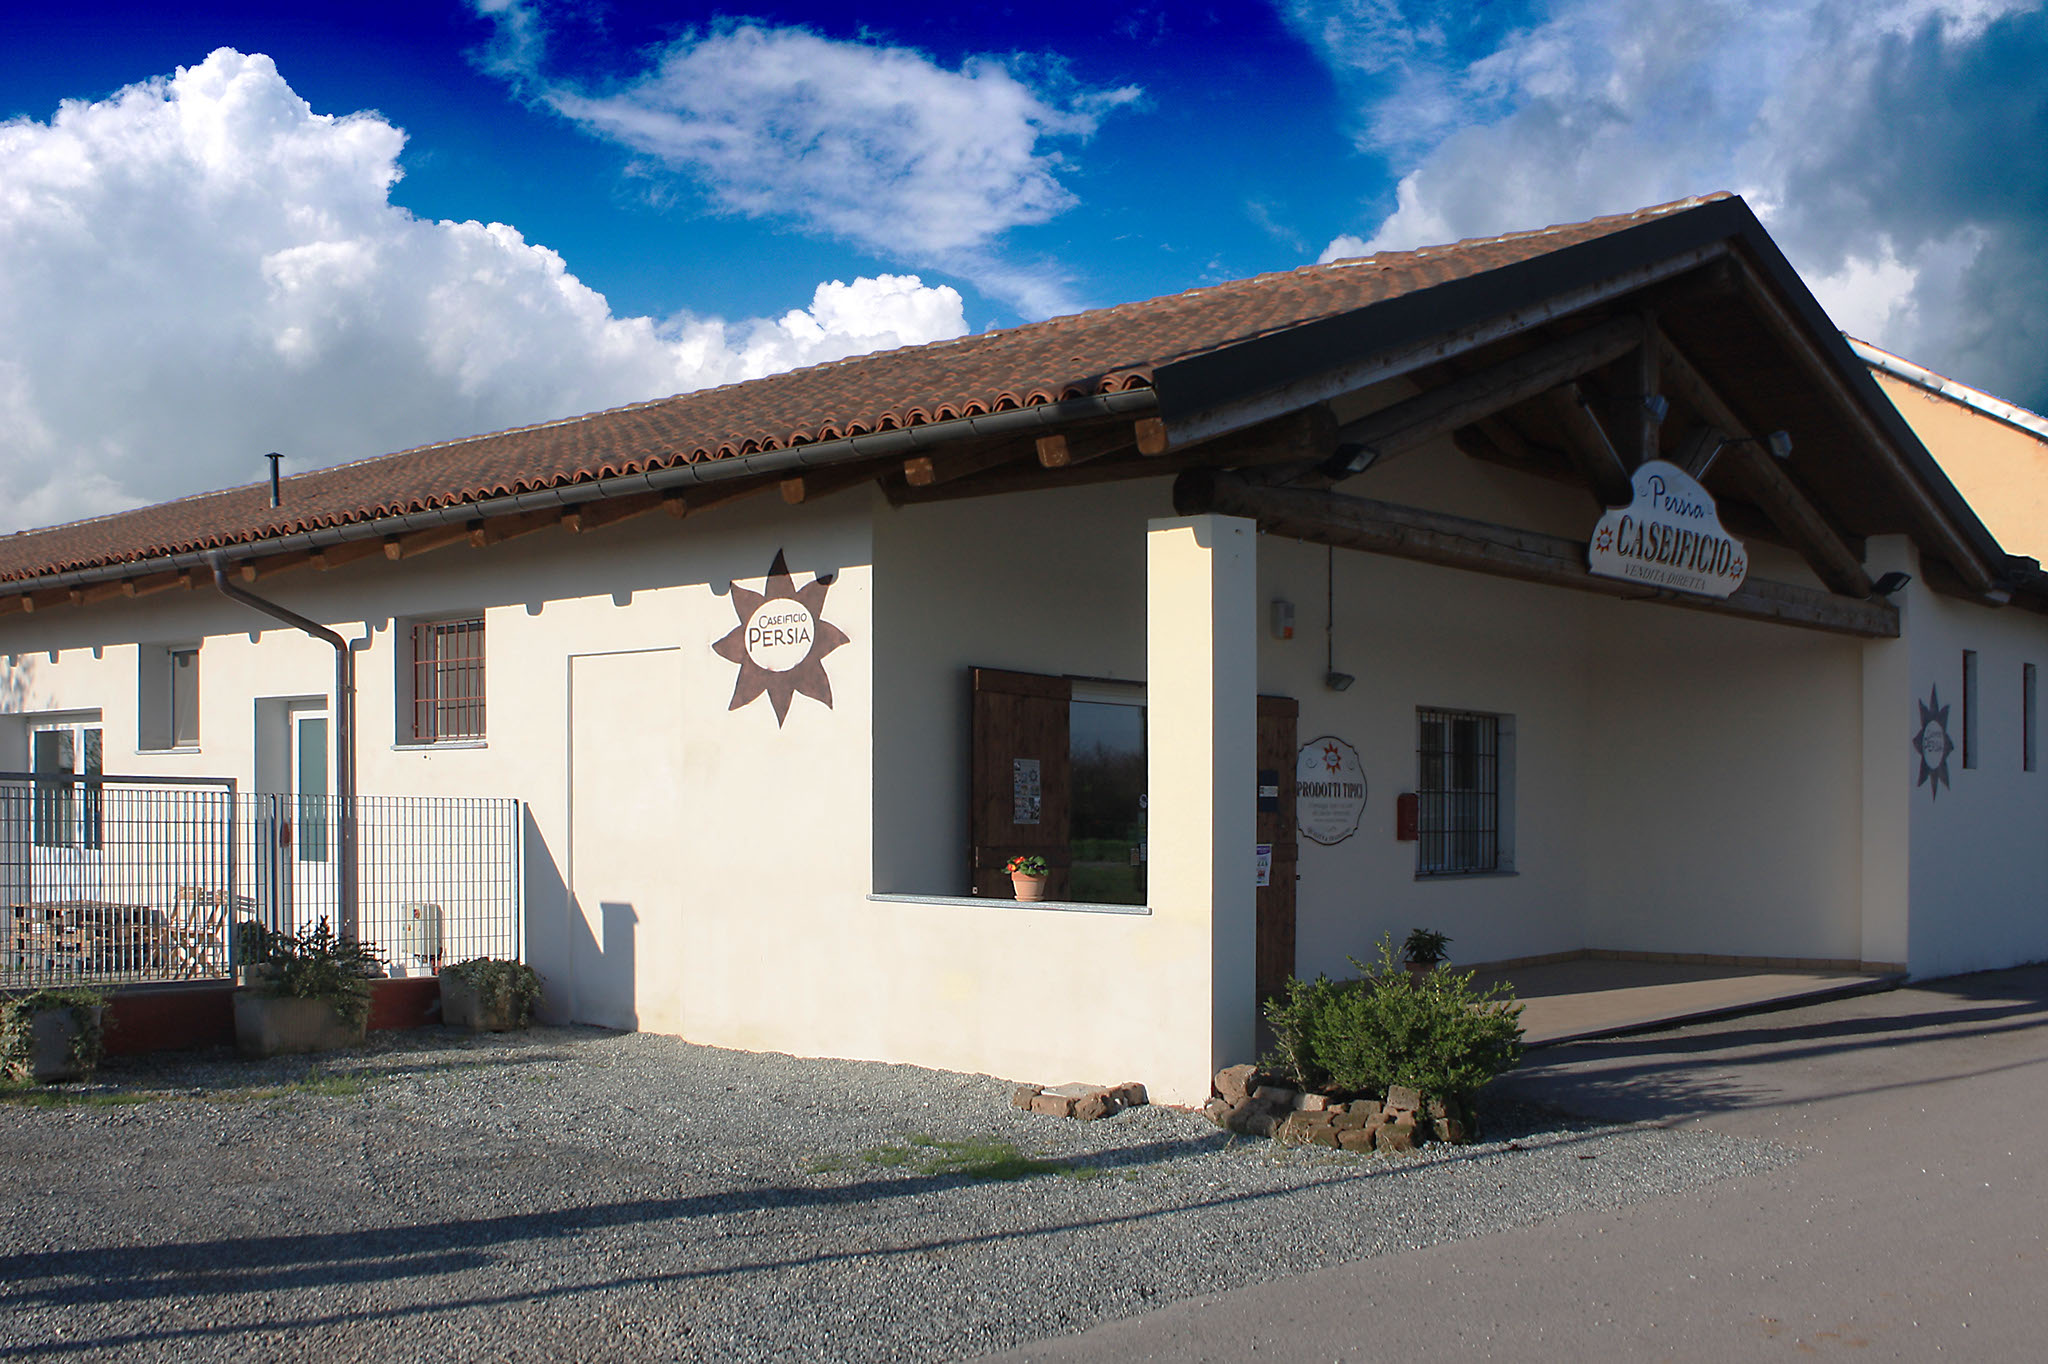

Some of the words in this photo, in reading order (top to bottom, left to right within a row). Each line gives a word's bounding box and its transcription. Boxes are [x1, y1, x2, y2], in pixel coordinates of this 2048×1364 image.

[1648, 474, 1704, 520] Persia
[1616, 514, 1731, 577] CASEIFICIO
[1624, 563, 1665, 583] VENDITA
[1666, 572, 1706, 590] DIRETTA
[759, 613, 807, 629] CASEIFICIO
[749, 627, 811, 652] PERSIA
[1296, 781, 1341, 799] PRODOTTI
[1343, 782, 1363, 799] TIPICI
